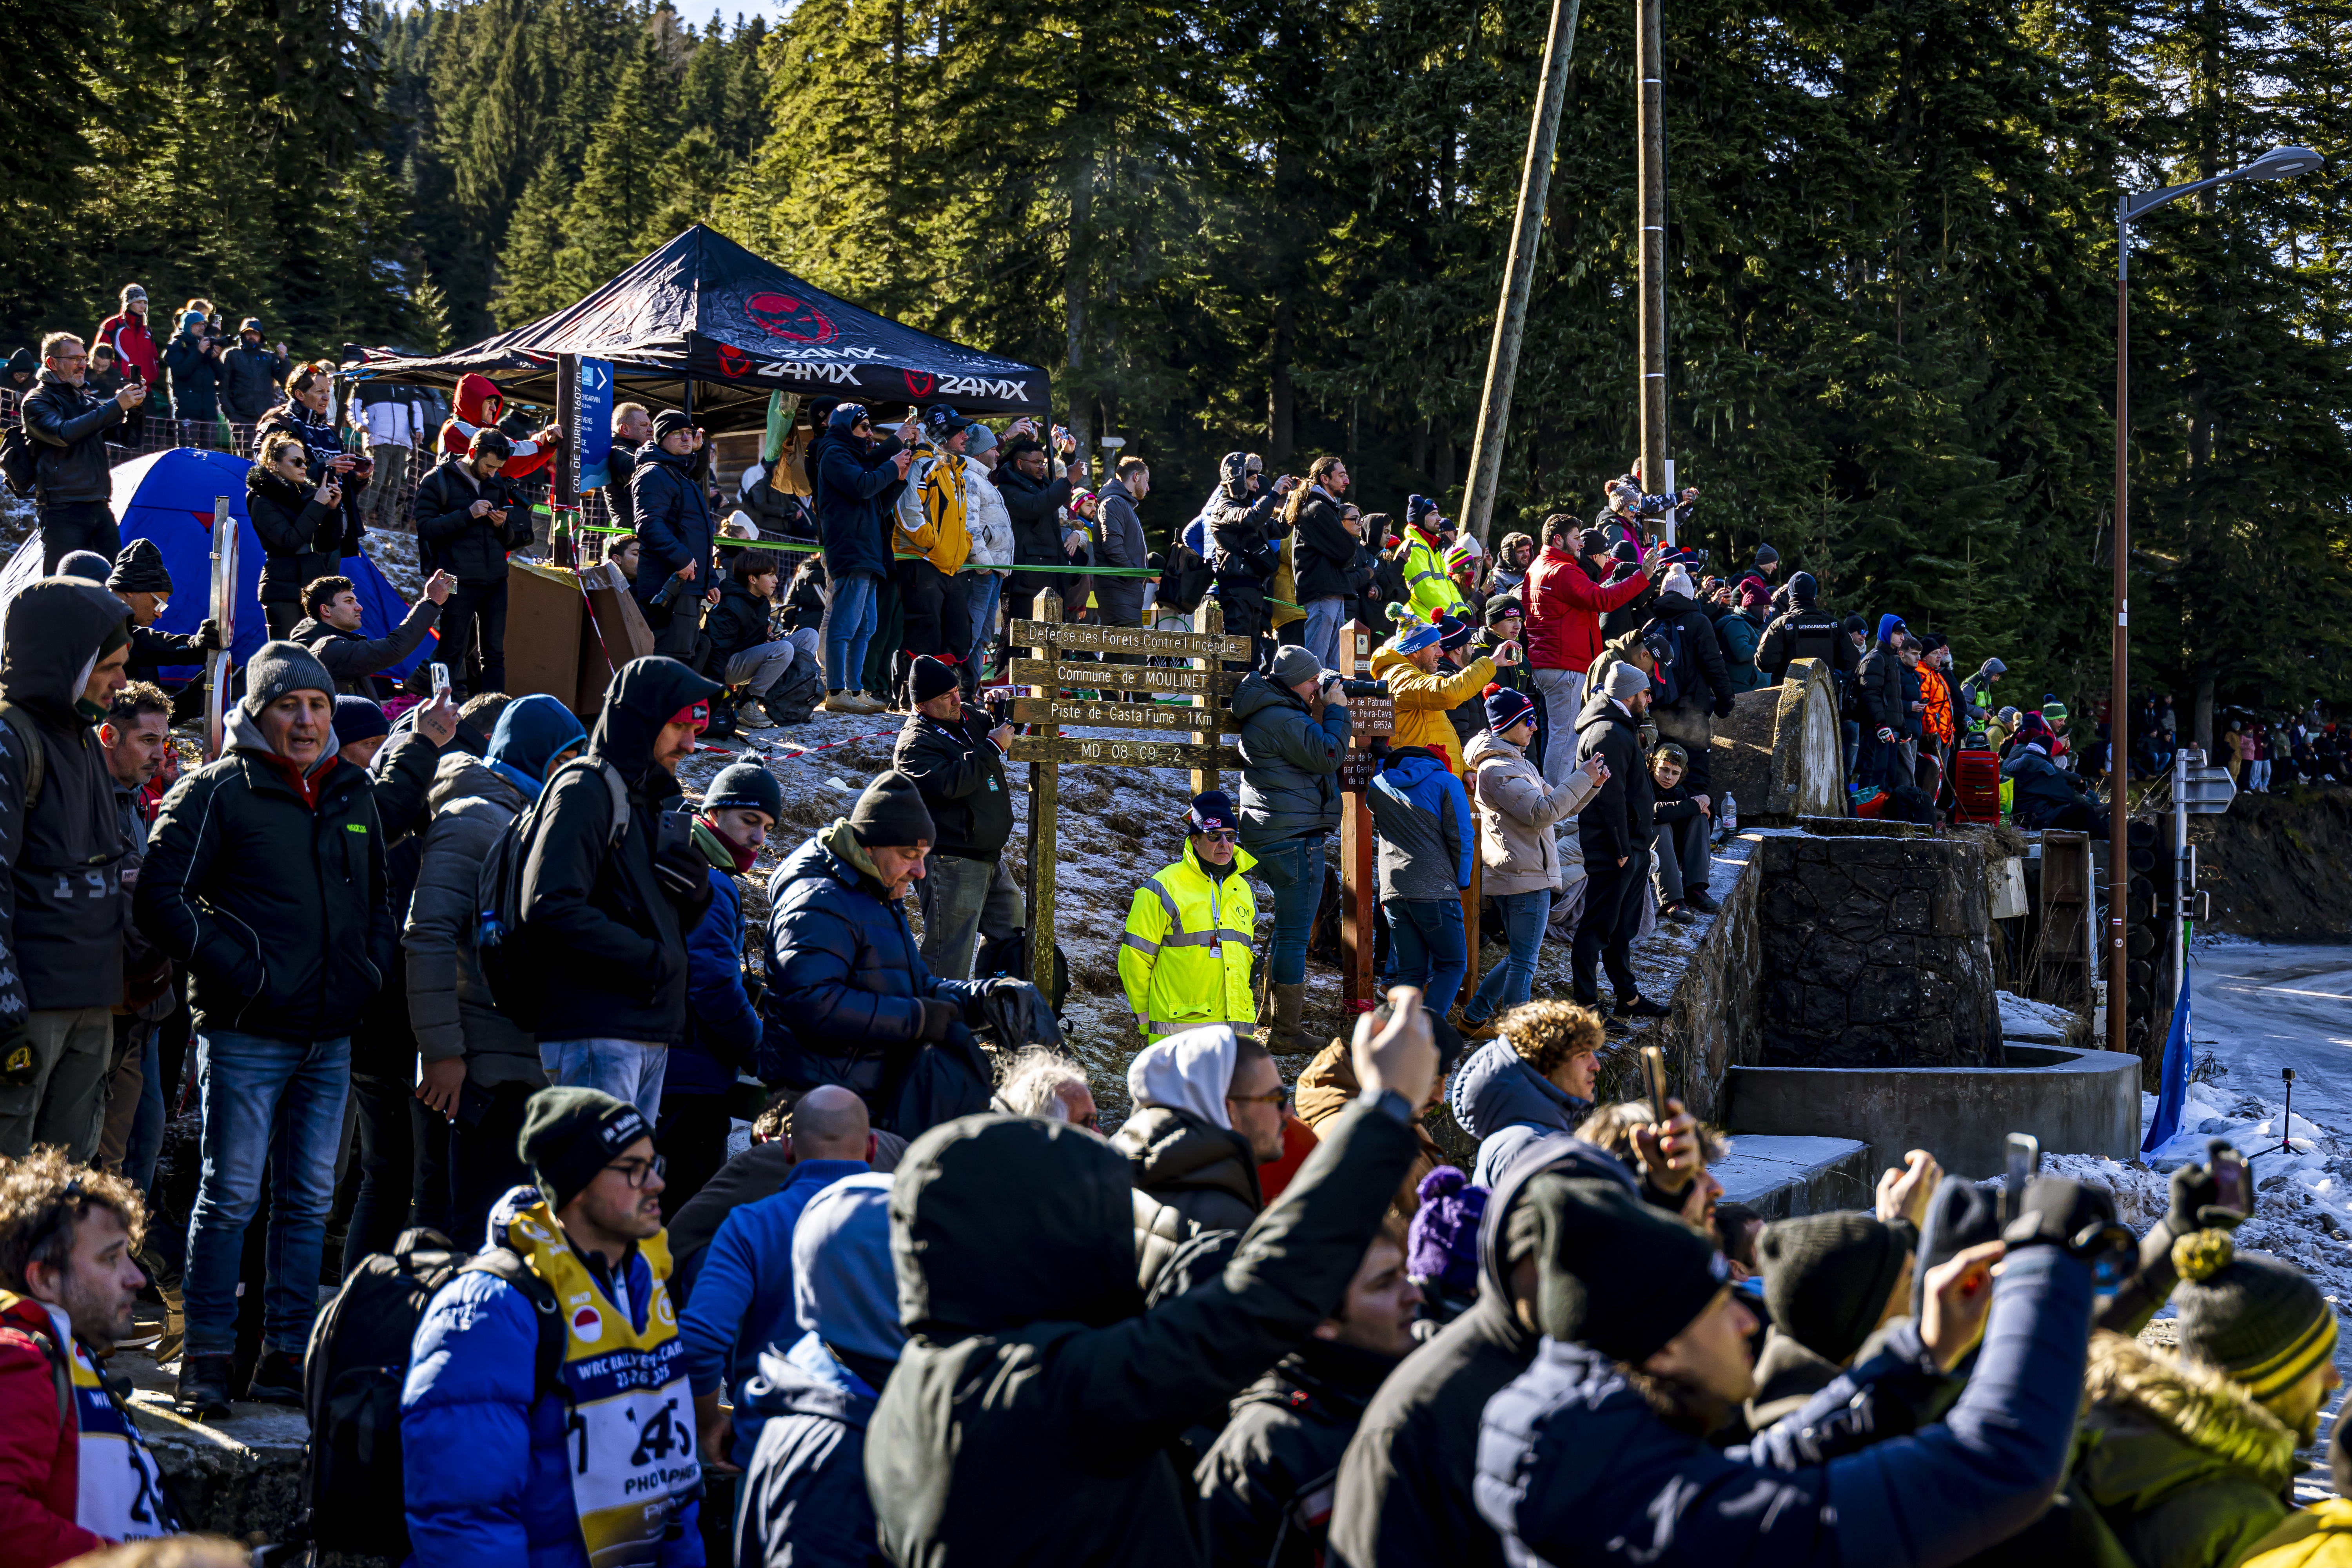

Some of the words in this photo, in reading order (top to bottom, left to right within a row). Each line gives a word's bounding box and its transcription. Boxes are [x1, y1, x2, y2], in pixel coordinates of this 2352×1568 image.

[576, 372, 582, 382] m
[757, 362, 862, 385] ZAMX
[937, 373, 1029, 401] ZAMX
[581, 416, 593, 425] EVENS
[573, 454, 581, 468] DE
[1080, 630, 1098, 644] des
[1143, 634, 1180, 649] Contre
[1401, 642, 1422, 656] ASSIC
[1058, 666, 1111, 682] Commune
[1122, 670, 1134, 684] de
[1146, 671, 1207, 688] MOULINET
[1357, 698, 1364, 706] de
[1367, 698, 1392, 706] Patronel
[1051, 703, 1080, 718] Piste
[1089, 706, 1101, 719] de
[1188, 711, 1192, 724] 1
[1196, 712, 1212, 725] Km
[1359, 710, 1392, 718] Peira-Cava
[1374, 721, 1392, 729] GR52A
[1082, 743, 1100, 757] MD
[1112, 745, 1128, 759] 08
[1140, 746, 1156, 760] C9
[1358, 753, 1365, 761] de
[1349, 776, 1356, 784] de
[576, 1358, 609, 1379] WRC
